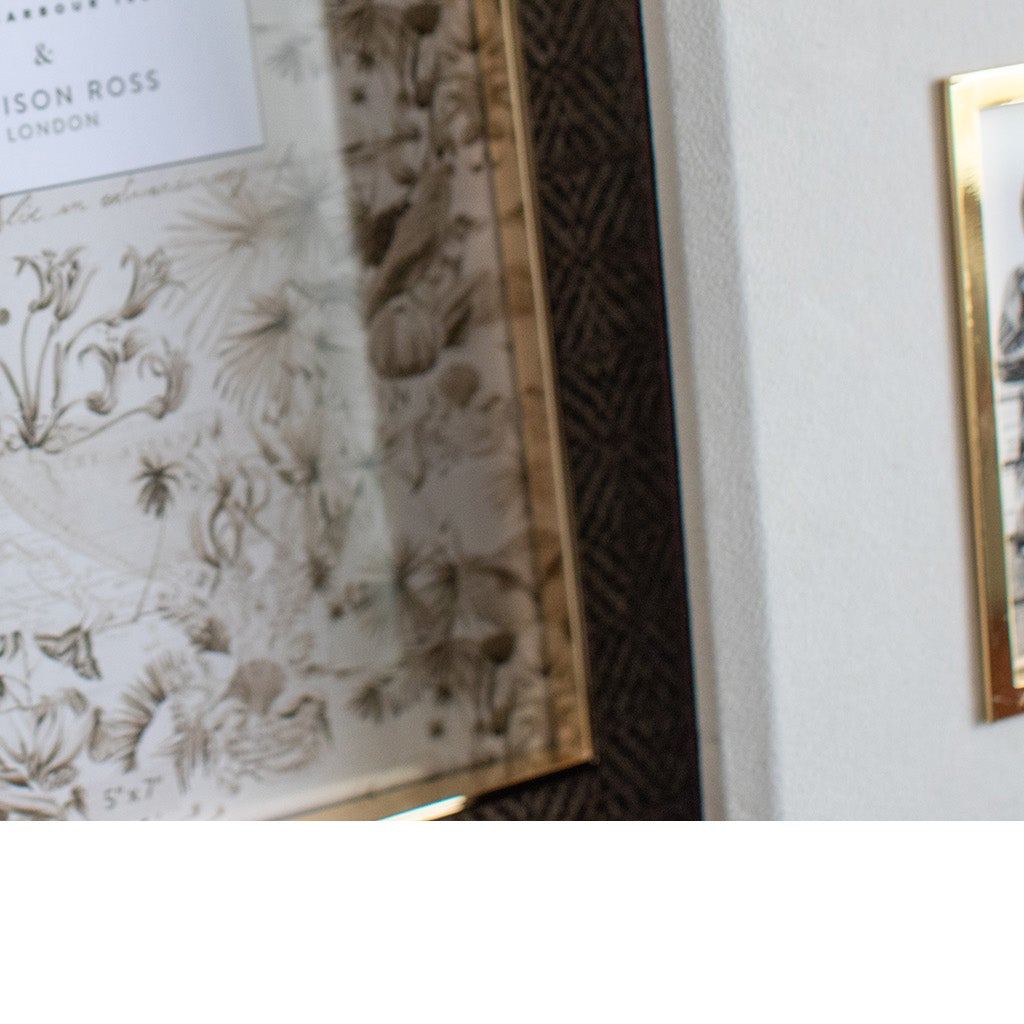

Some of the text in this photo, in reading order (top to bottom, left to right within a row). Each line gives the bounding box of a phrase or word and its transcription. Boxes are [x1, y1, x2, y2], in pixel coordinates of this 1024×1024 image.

[33, 42, 54, 67] &
[86, 68, 161, 101] ROSS
[6, 112, 100, 143] LONDON
